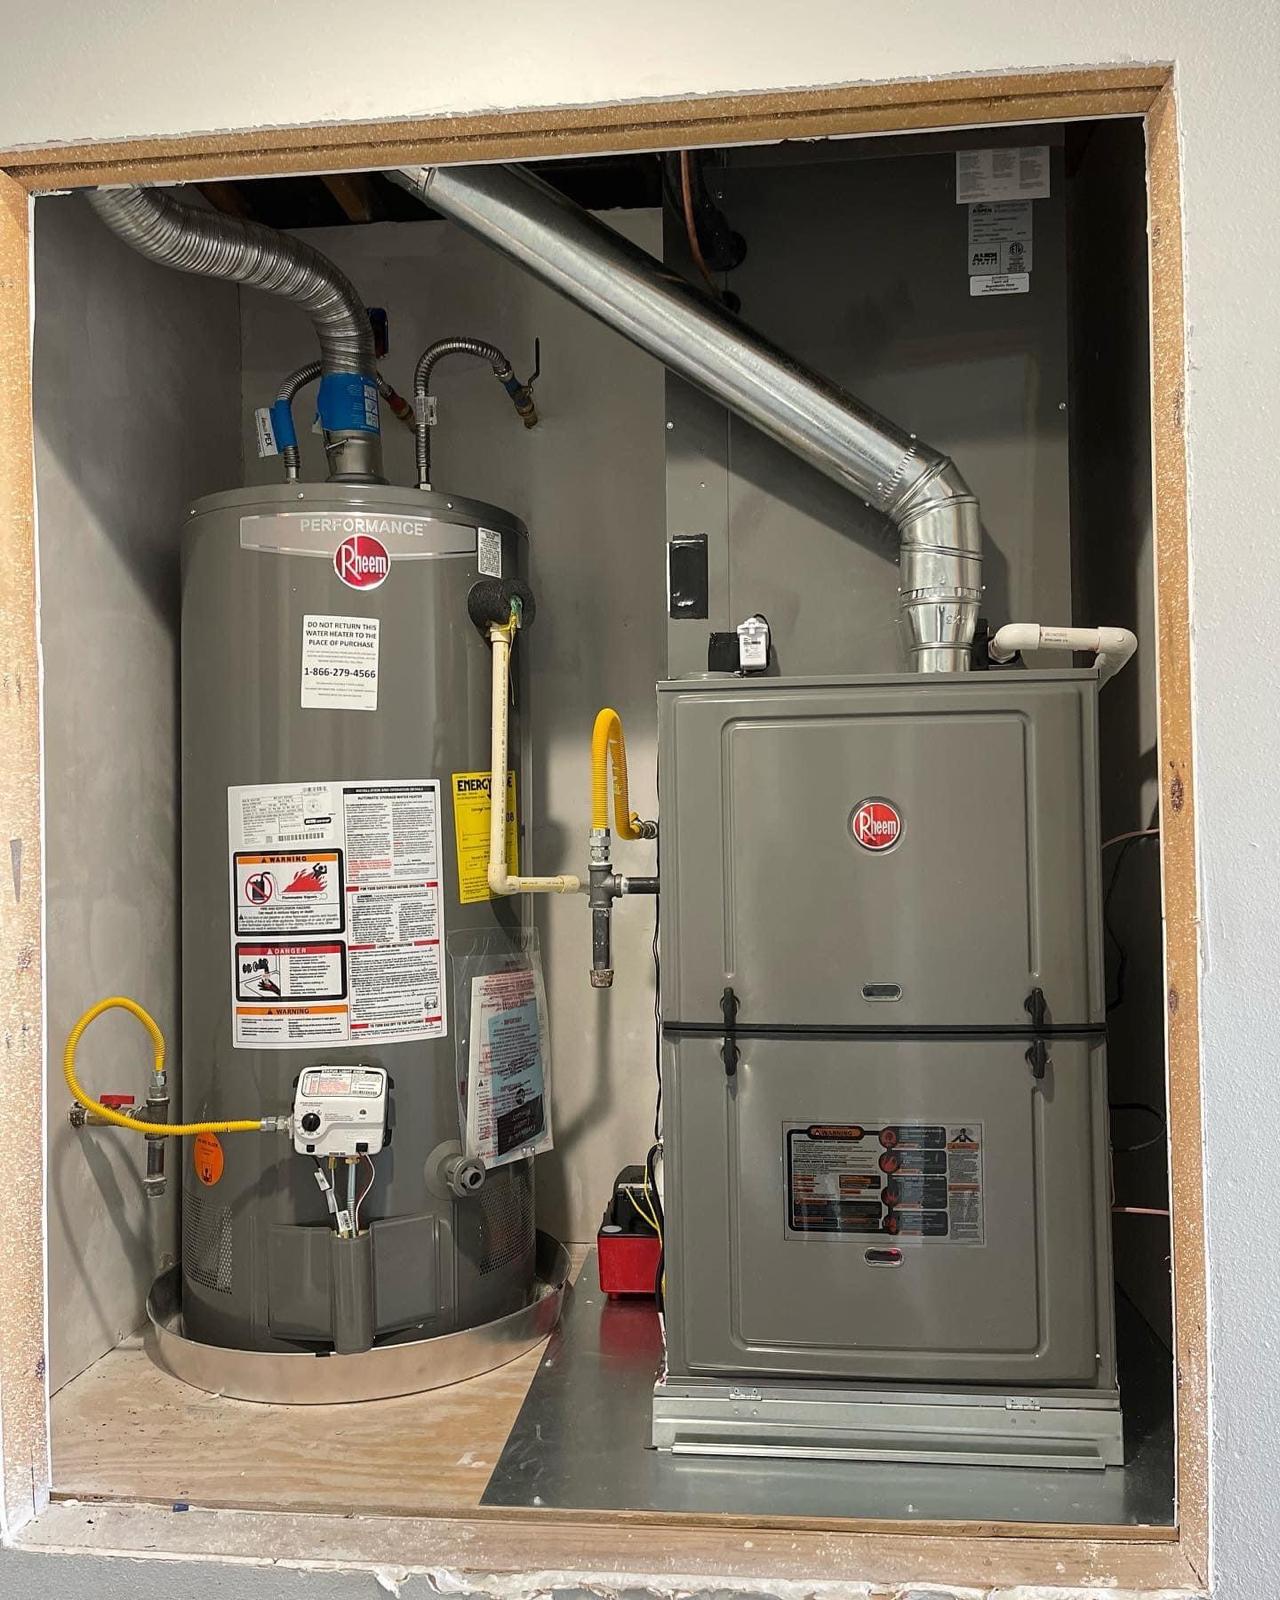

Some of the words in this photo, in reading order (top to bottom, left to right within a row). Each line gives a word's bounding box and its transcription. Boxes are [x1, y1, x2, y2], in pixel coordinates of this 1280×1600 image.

[264, 432, 273, 446] PEX
[300, 518, 424, 536] PERFORMANCE
[341, 535, 387, 580] Rheem
[335, 622, 361, 630] RETURN
[340, 640, 374, 648] PURCHASE
[304, 667, 376, 679] 1-866-279-4566
[860, 806, 896, 841] Rheem
[275, 1008, 309, 1016] WARNING
